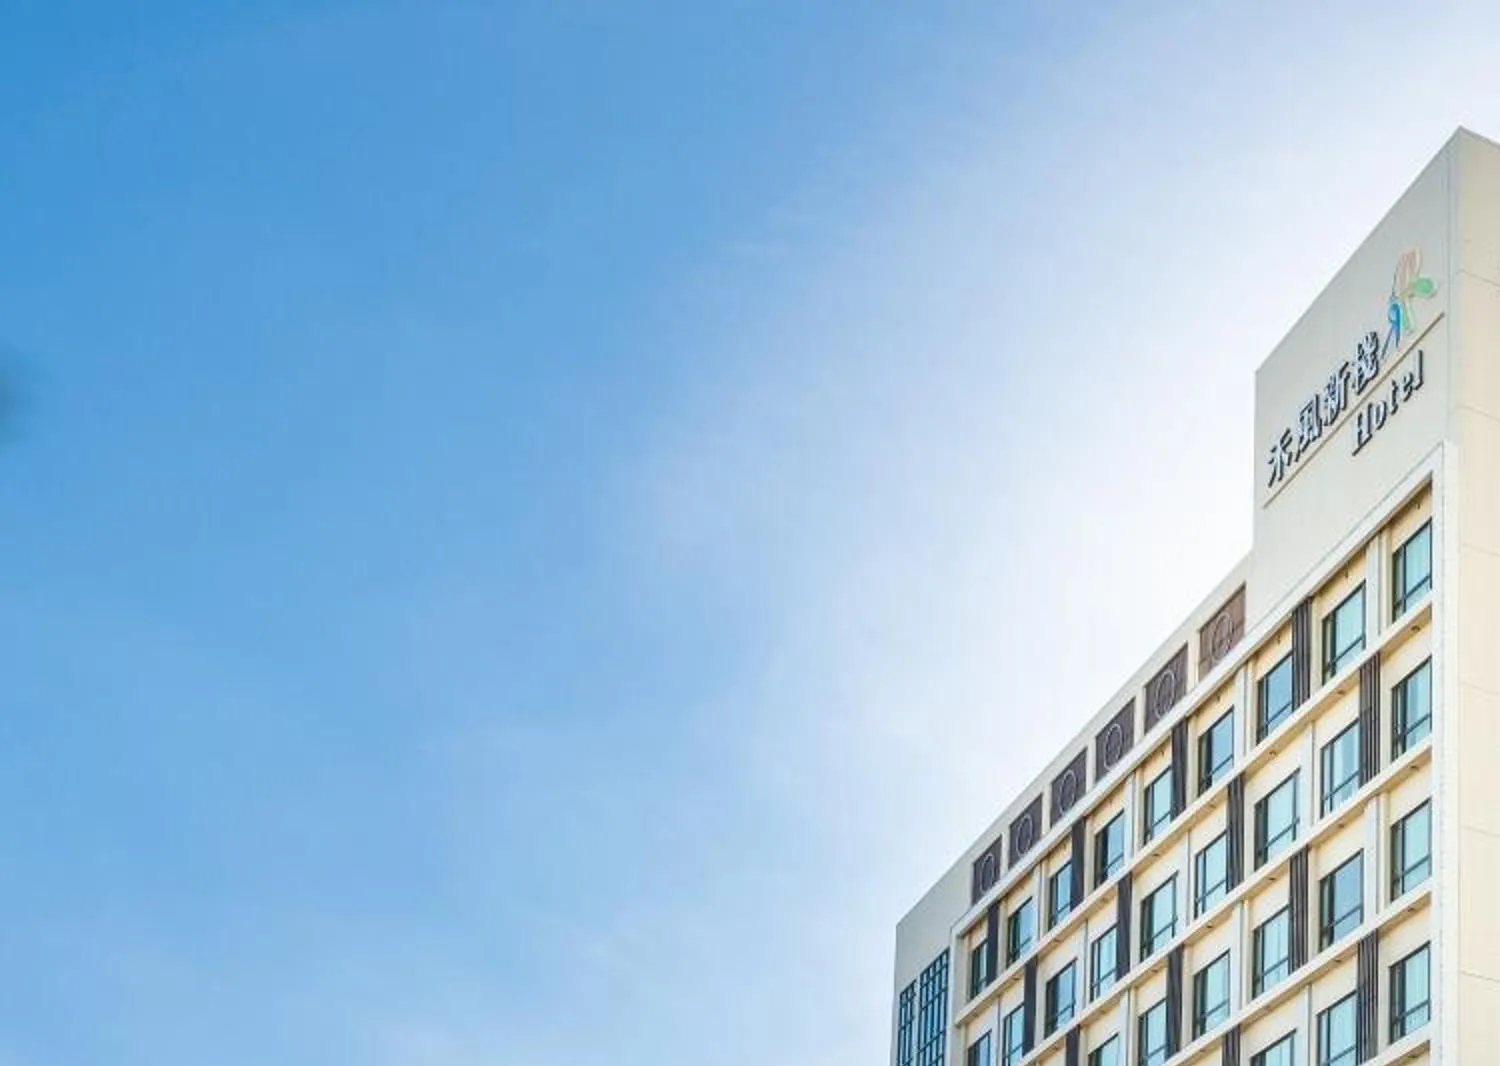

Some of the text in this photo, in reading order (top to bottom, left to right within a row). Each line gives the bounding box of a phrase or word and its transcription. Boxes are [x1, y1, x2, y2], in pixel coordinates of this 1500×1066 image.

[1267, 331, 1379, 488] 禾風新棧
[1352, 349, 1424, 457] Hotel
